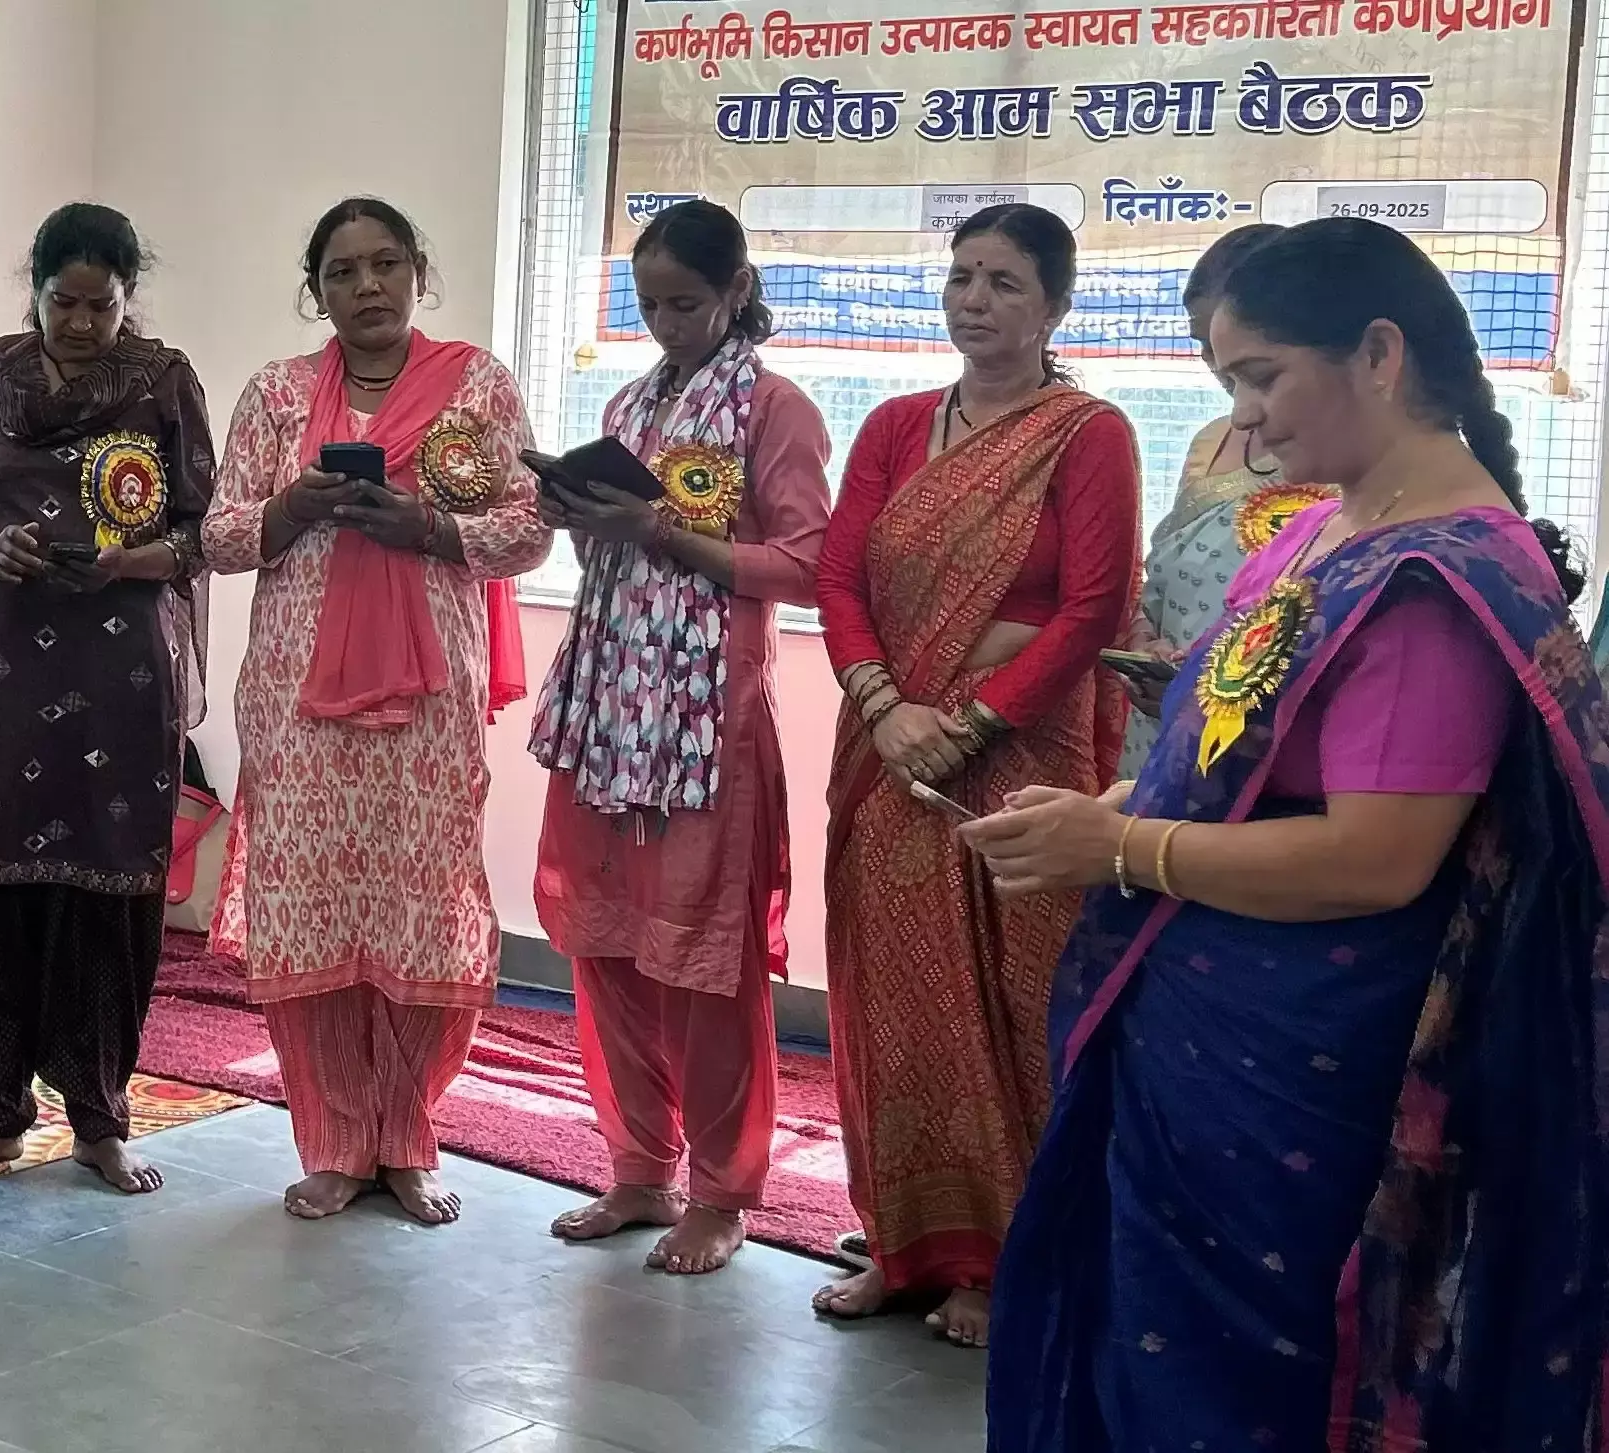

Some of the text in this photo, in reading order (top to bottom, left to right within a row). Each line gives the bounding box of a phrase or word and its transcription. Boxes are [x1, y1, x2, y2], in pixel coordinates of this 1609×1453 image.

[634, 12, 754, 78] कर्णभूमि
[763, 10, 873, 59] किसान
[880, 14, 1016, 56] उत्पादक
[1024, 8, 1142, 50] स्वायत
[716, 61, 1434, 142] वार्षिक आम सभा बैठक
[1330, 203, 1430, 218] 26-09-2025
